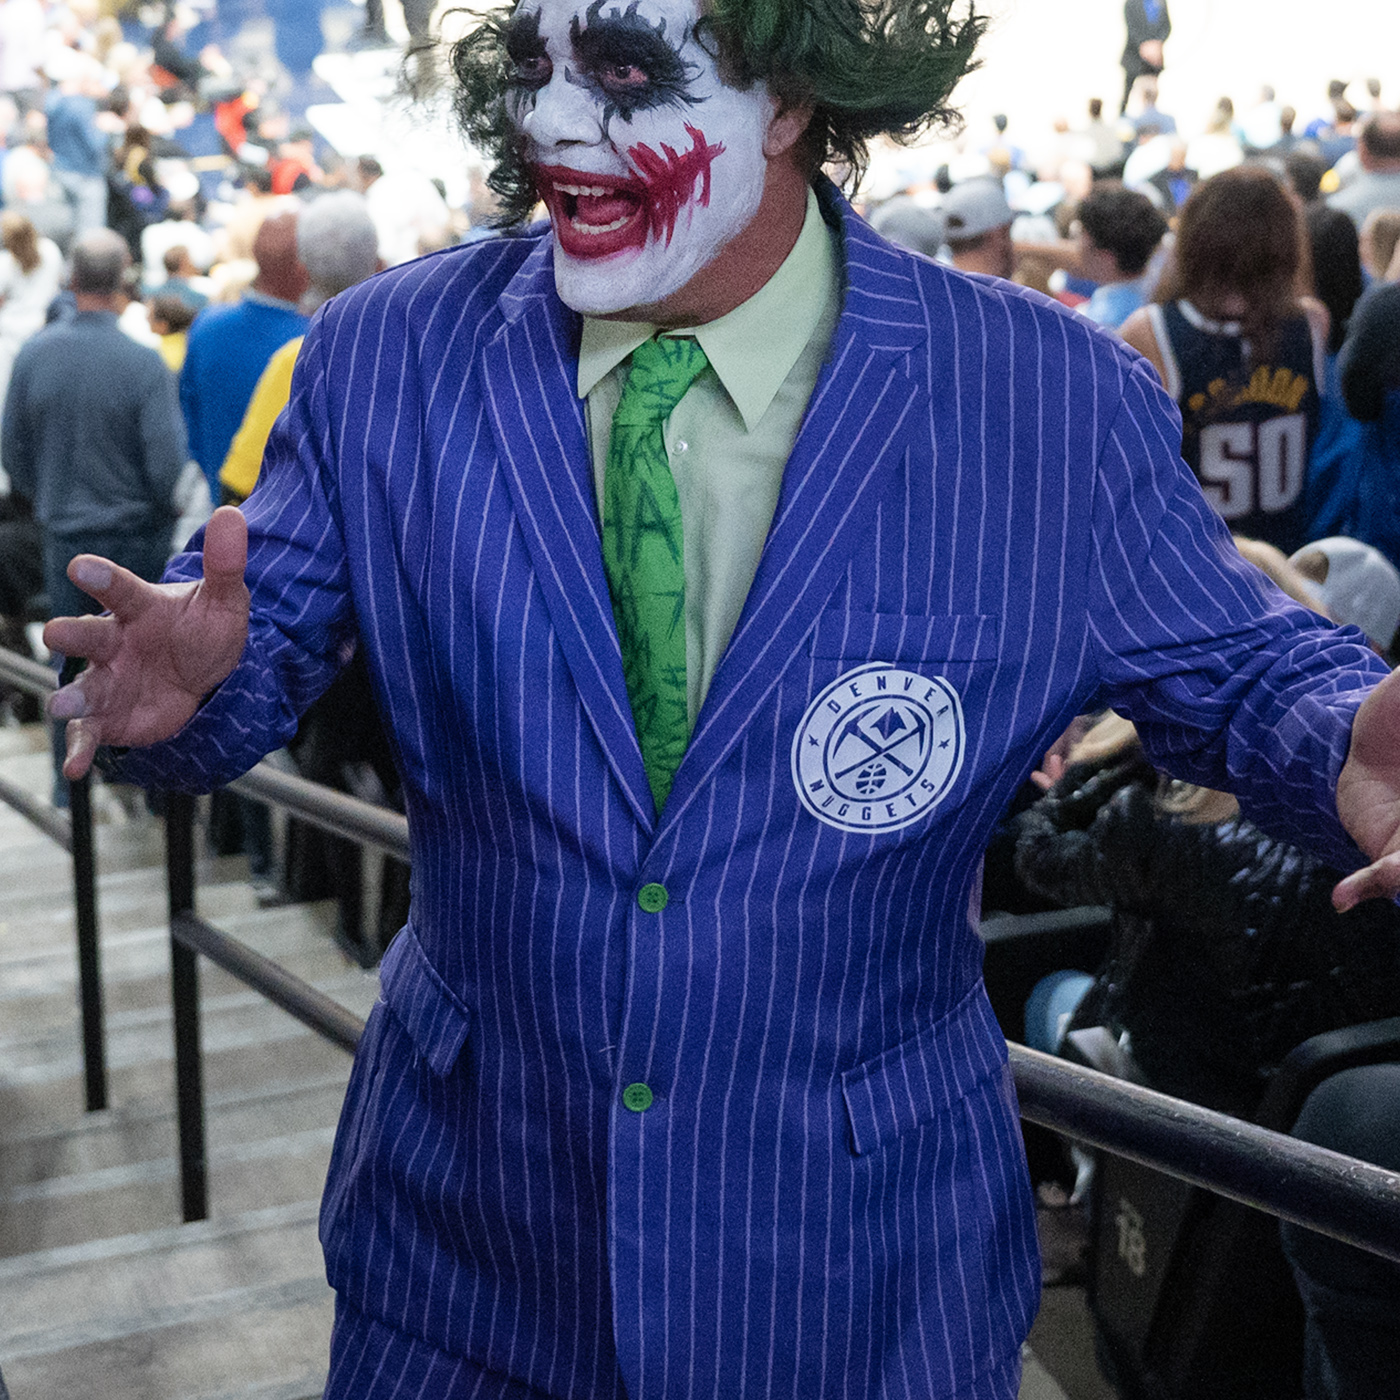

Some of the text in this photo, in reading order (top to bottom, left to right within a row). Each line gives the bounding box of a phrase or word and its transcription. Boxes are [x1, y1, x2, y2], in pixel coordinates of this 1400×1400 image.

[1200, 413, 1307, 519] 50
[826, 675, 950, 718] DENVER
[808, 778, 936, 821] NUGGETS
